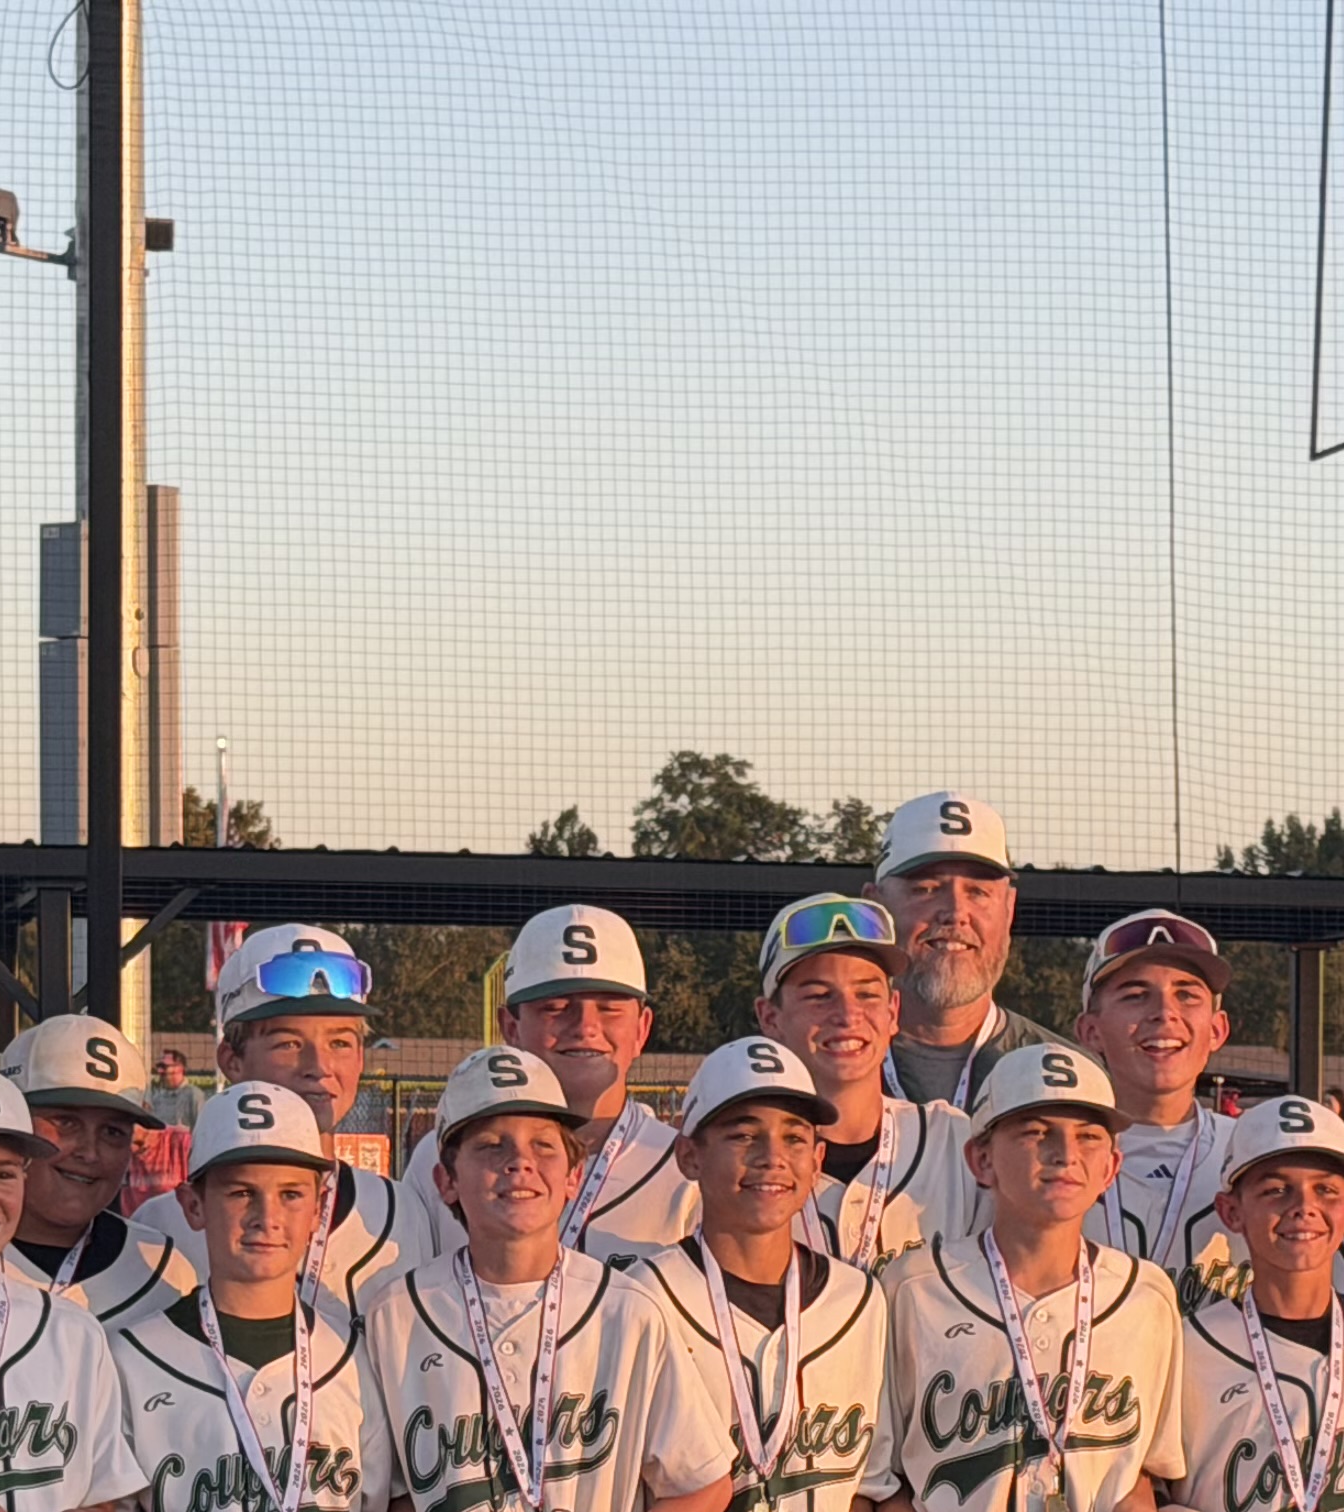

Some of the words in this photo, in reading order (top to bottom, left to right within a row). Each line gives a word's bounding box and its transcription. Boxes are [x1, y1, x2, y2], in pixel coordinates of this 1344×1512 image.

[939, 801, 973, 836] S
[562, 924, 598, 966] S
[86, 1037, 120, 1082] S
[237, 1093, 275, 1130] S
[292, 1463, 301, 1488] 2026
